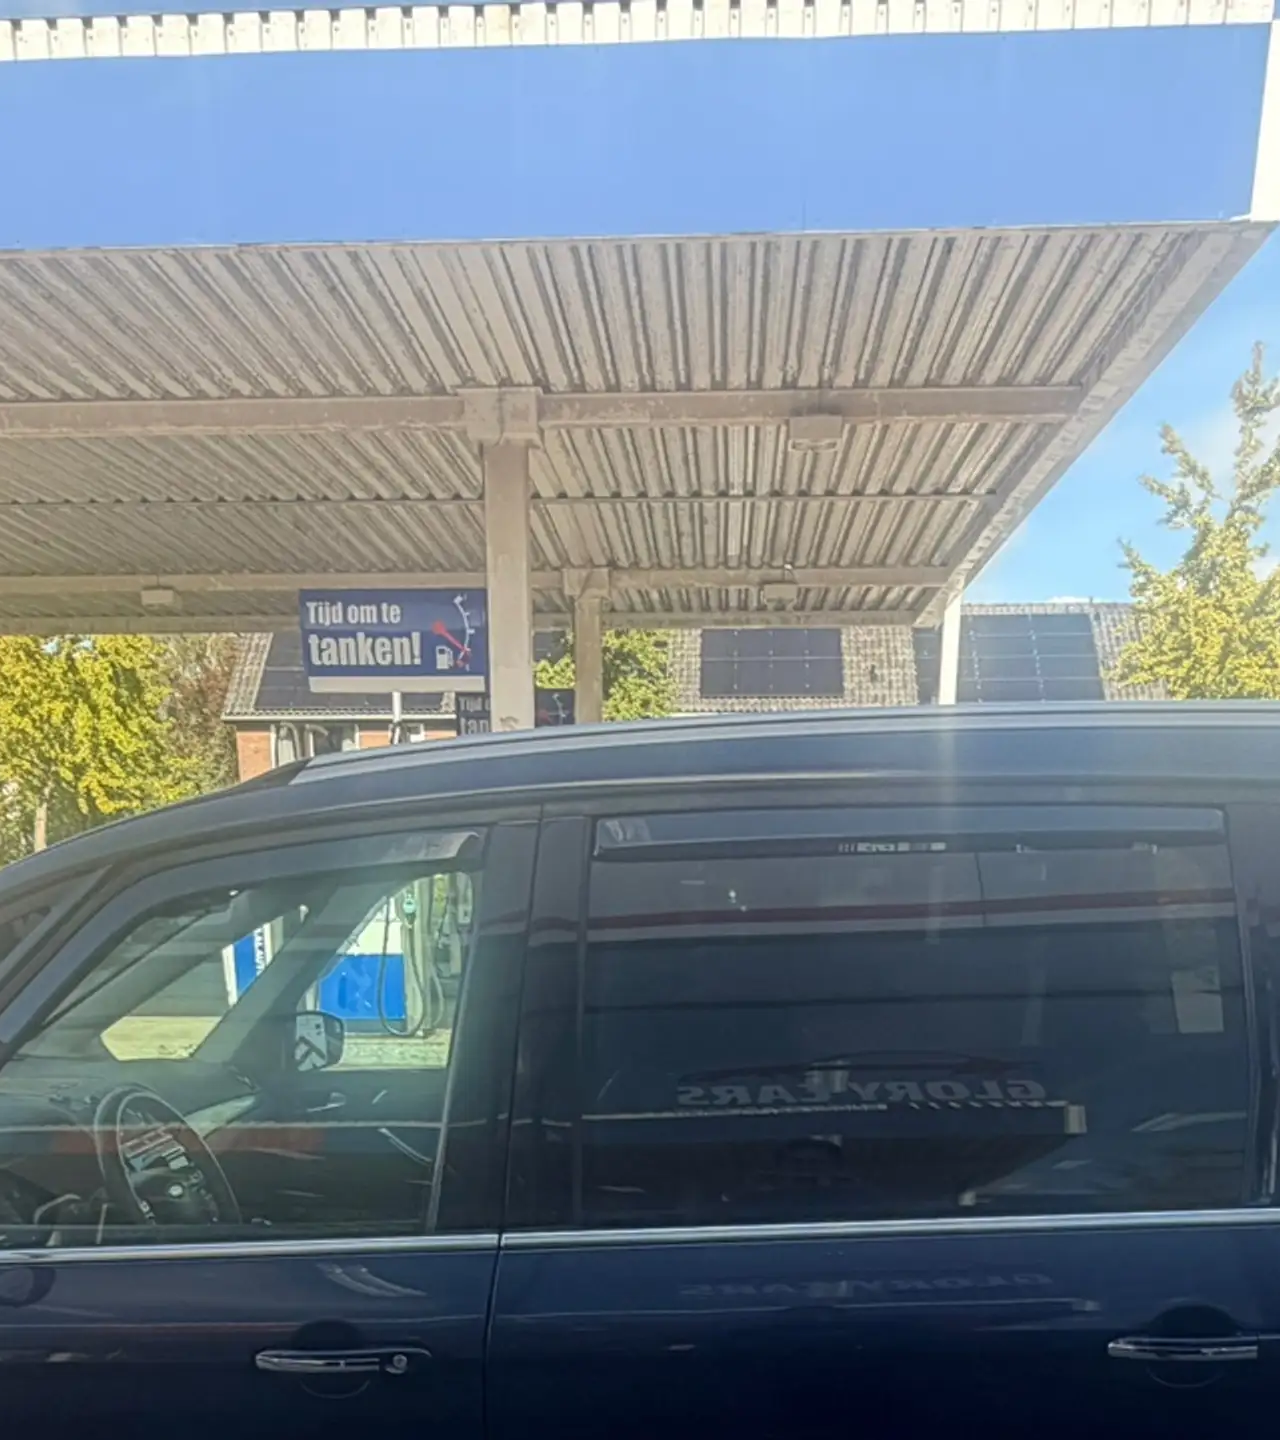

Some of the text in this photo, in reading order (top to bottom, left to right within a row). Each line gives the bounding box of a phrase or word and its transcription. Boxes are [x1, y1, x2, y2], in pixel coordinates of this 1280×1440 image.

[306, 601, 401, 626] Tijd om te
[309, 631, 421, 666] tanken!
